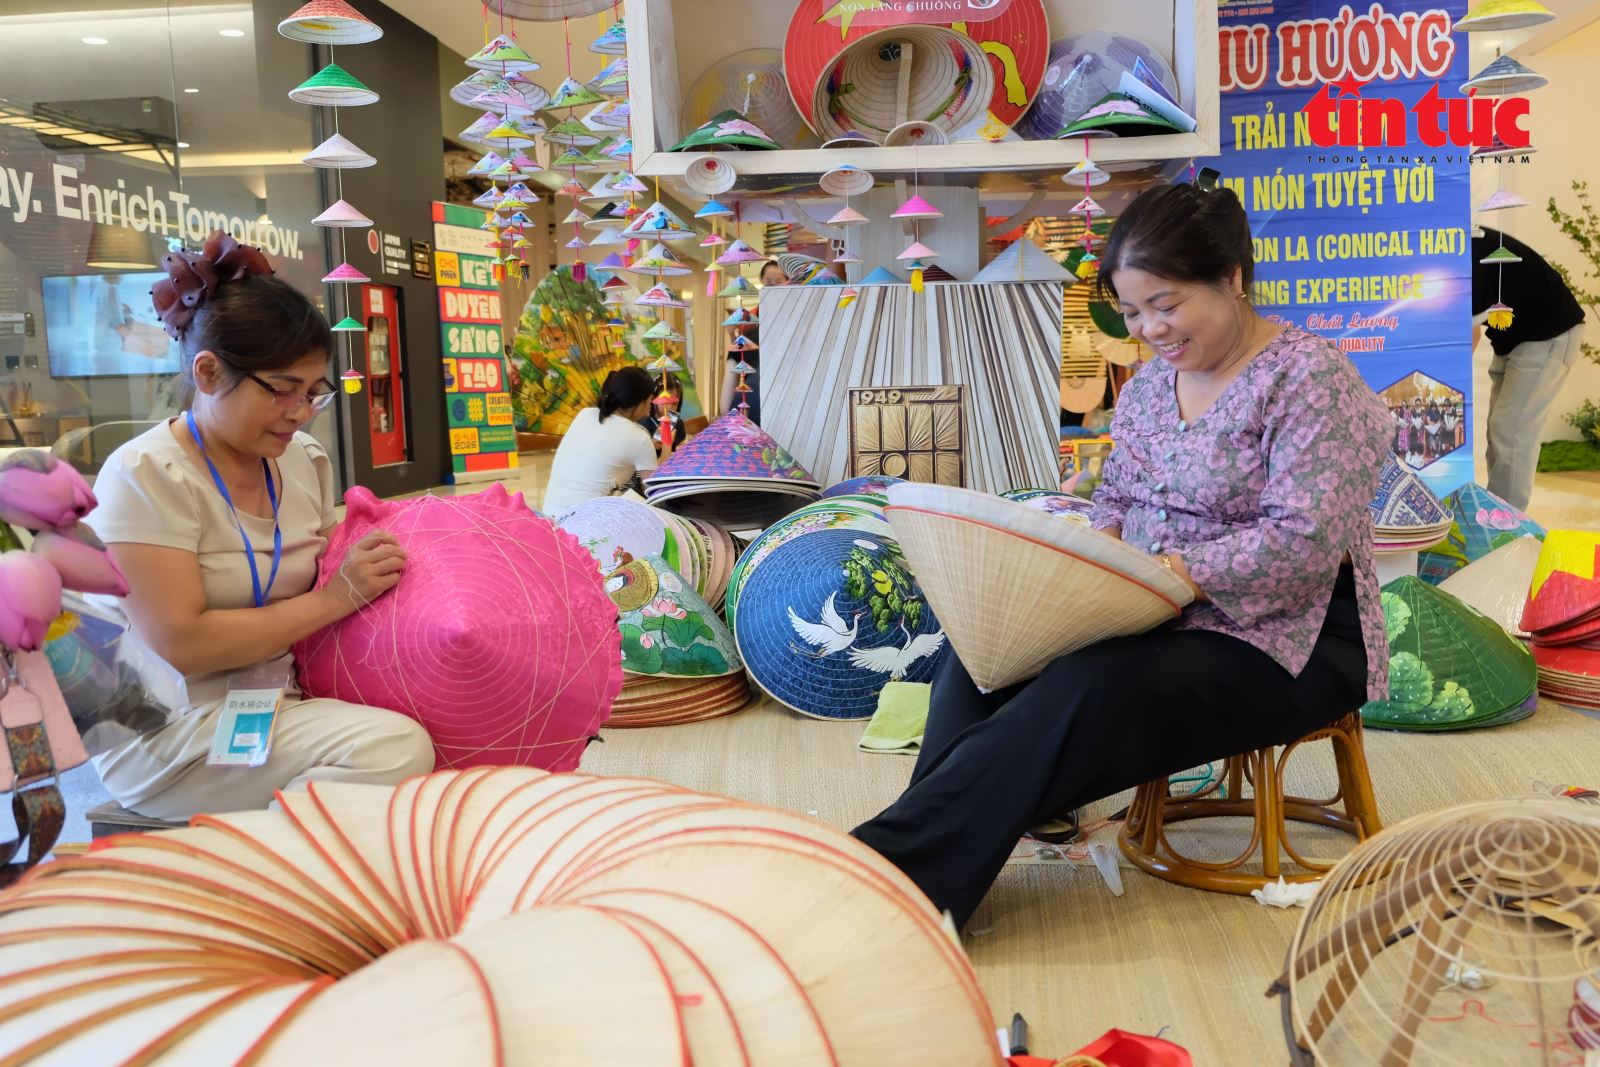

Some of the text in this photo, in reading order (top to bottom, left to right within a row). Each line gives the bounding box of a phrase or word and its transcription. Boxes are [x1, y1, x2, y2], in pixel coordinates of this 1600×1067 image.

[1277, 3, 1455, 86] HƯƠNG
[1232, 101, 1286, 150] TRẢI
[1253, 168, 1305, 211] NÓN
[1312, 162, 1387, 214] TUYỆT
[1393, 158, 1434, 204] VỜI
[52, 163, 168, 235] Enrich
[169, 191, 303, 260] Tomorrow.
[1252, 228, 1465, 263] ON LA (CONICAL HAT)
[445, 291, 501, 319] DUYÊN
[1252, 274, 1425, 306] ING EXPERIENCE
[1306, 313, 1344, 331] Chất
[1346, 312, 1399, 332] Lượng
[448, 327, 500, 354] SÁNG
[1339, 336, 1386, 353] QUALITY
[853, 390, 902, 405] 1949
